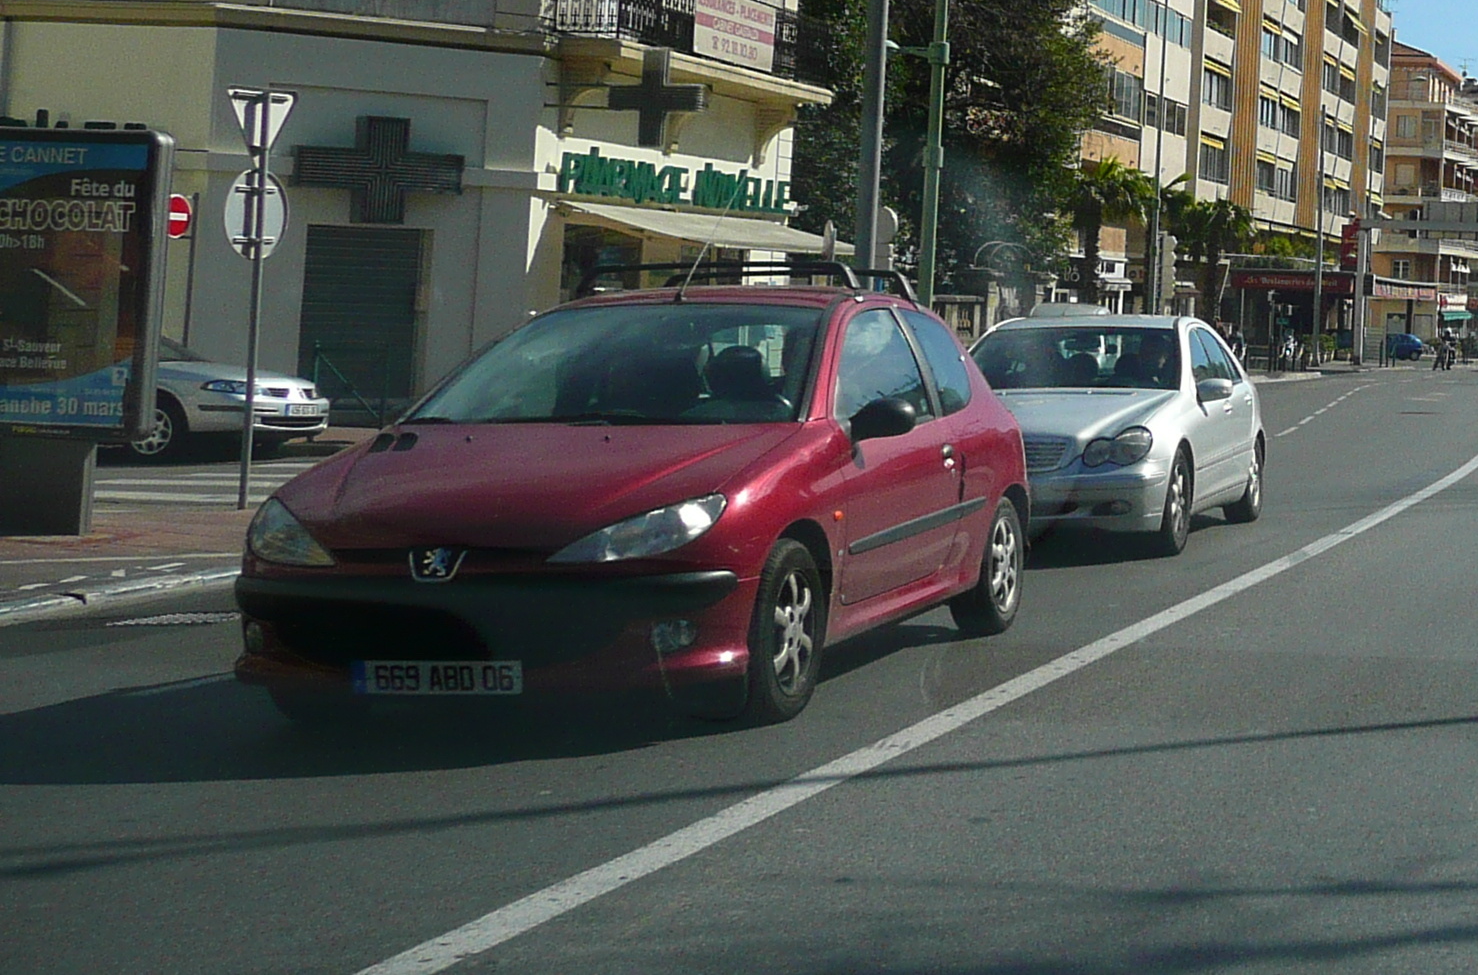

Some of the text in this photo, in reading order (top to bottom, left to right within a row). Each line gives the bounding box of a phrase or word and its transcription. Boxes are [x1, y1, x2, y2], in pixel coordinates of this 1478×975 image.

[11, 146, 88, 164] CANNET
[70, 177, 135, 197] Fête du
[56, 397, 79, 415] 30
[83, 401, 124, 416] mars
[374, 665, 514, 692] 669 ABD 06
